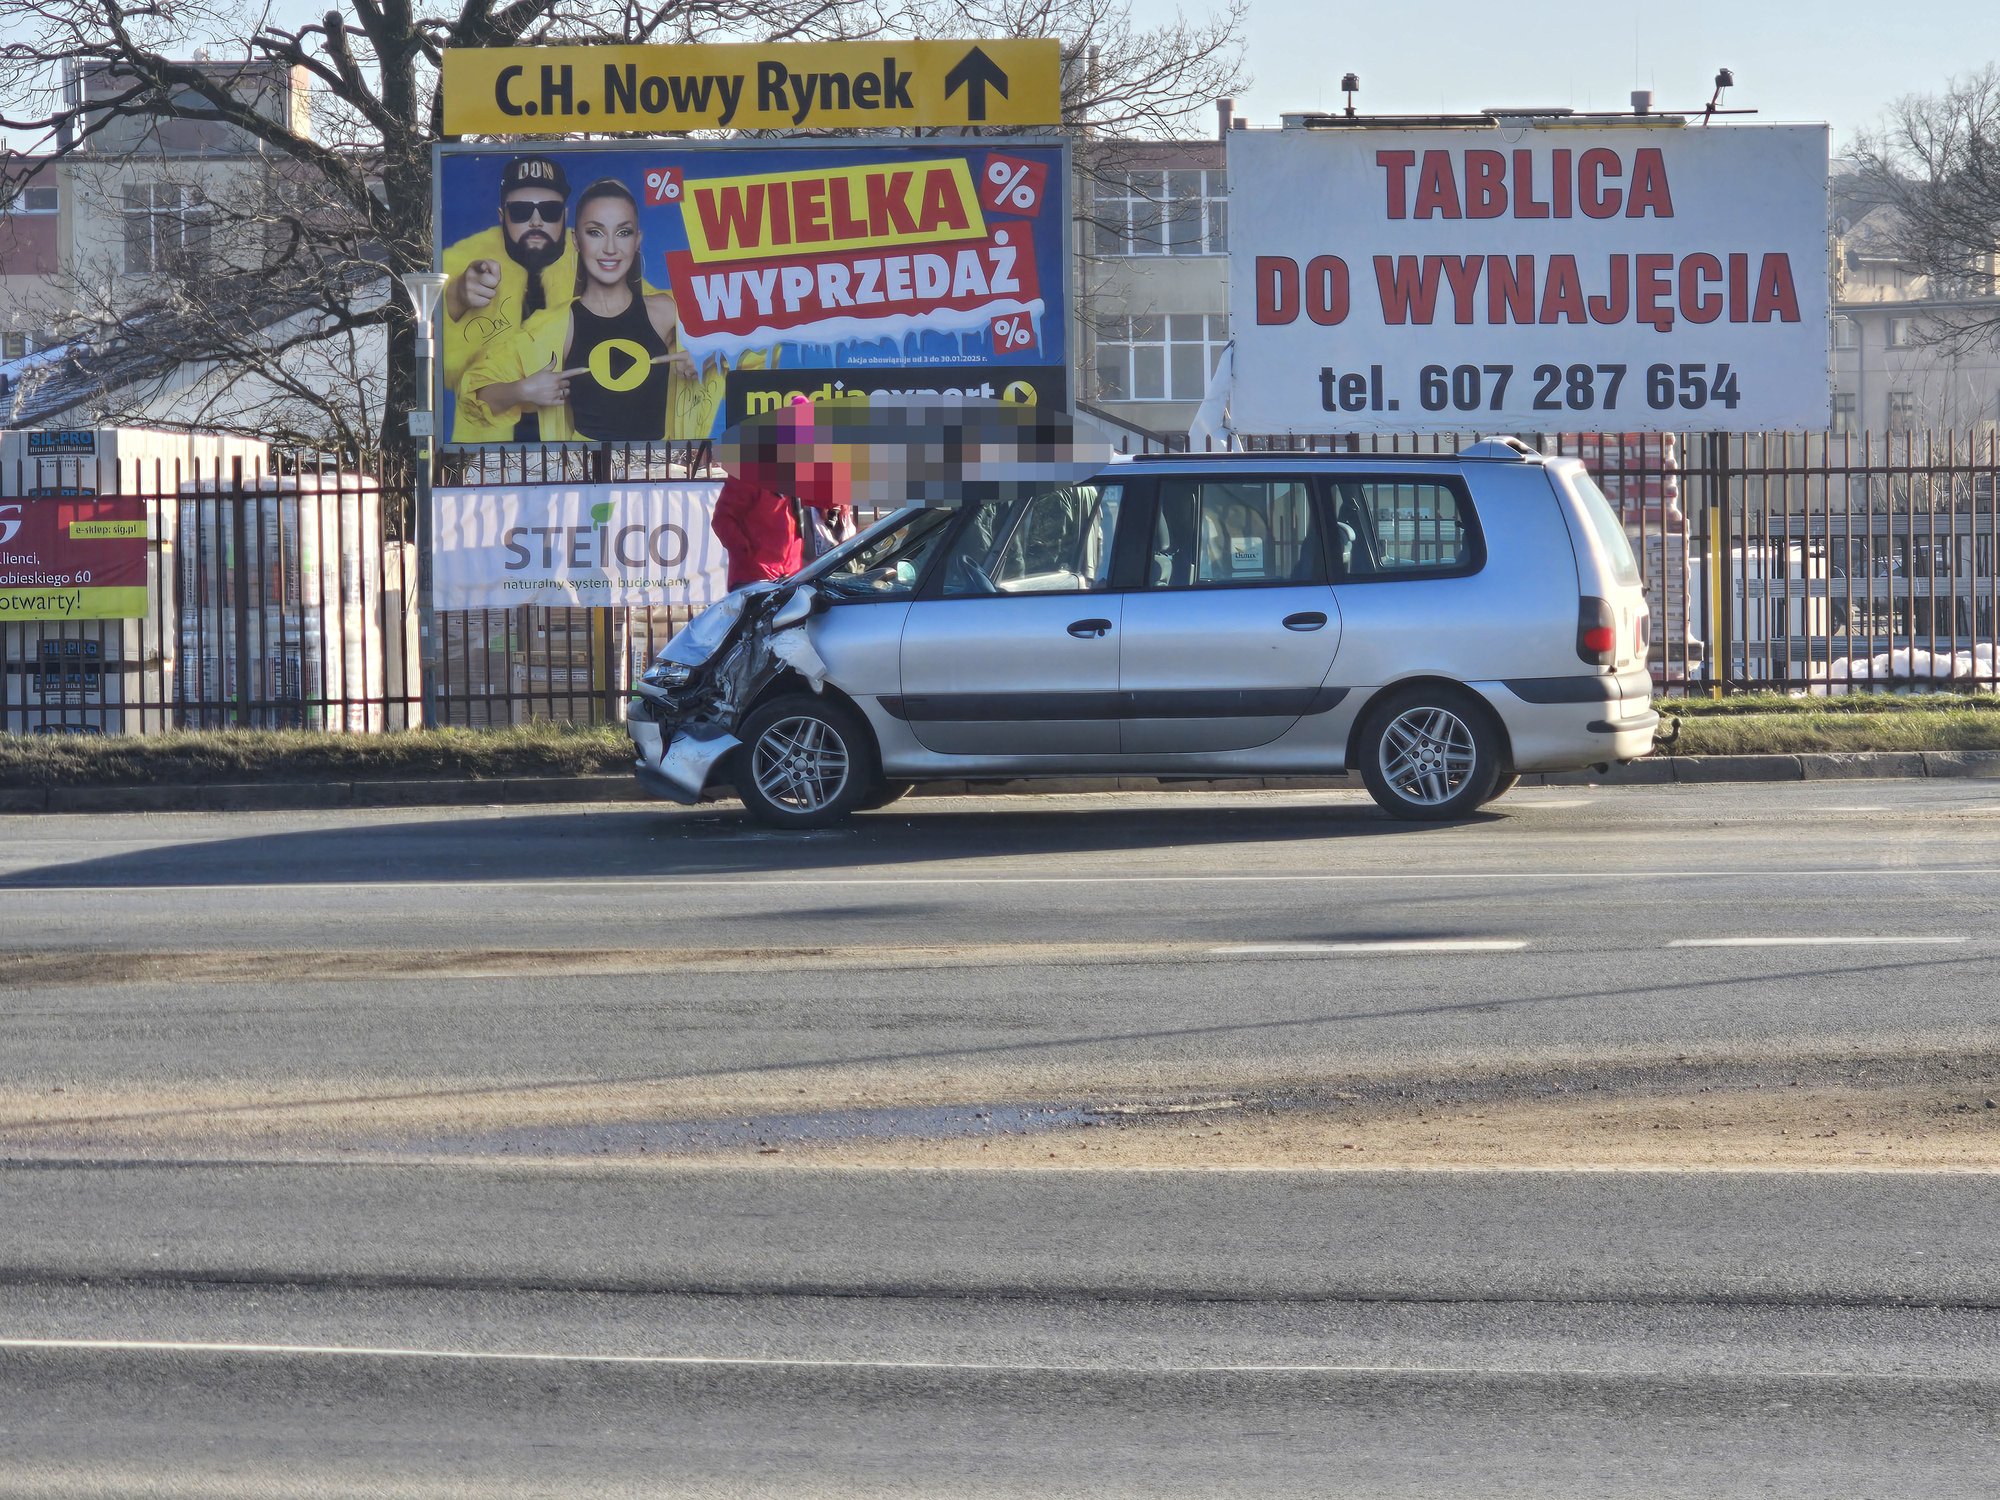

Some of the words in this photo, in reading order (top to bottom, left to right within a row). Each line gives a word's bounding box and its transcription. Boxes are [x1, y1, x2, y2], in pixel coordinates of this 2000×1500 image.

[495, 64, 590, 116] C.H.
[604, 63, 745, 127] Nowy
[757, 57, 914, 126] Rynek
[518, 161, 554, 180] DON
[1376, 147, 1674, 219] TABLICA
[693, 168, 971, 251] WIELKA
[691, 229, 1020, 322] WYPRZEDAŻ
[1255, 254, 1350, 326] DO
[1373, 252, 1801, 332] WYNAJĘCIA
[848, 356, 867, 364] Akcja
[868, 356, 911, 364] obowiązuje
[912, 355, 922, 363] od
[929, 355, 939, 363] do
[1318, 364, 1400, 412] tel.
[1419, 364, 1513, 411] 607
[1532, 363, 1627, 411] 287
[1646, 363, 1741, 410] 654
[31, 431, 92, 445] SIL-PRO
[0, 552, 40, 565] lienci,
[75, 570, 91, 583] 60
[503, 577, 565, 591] naturalny
[569, 578, 613, 591] system
[618, 576, 691, 590] budowlany
[0, 590, 81, 615] otwarty!
